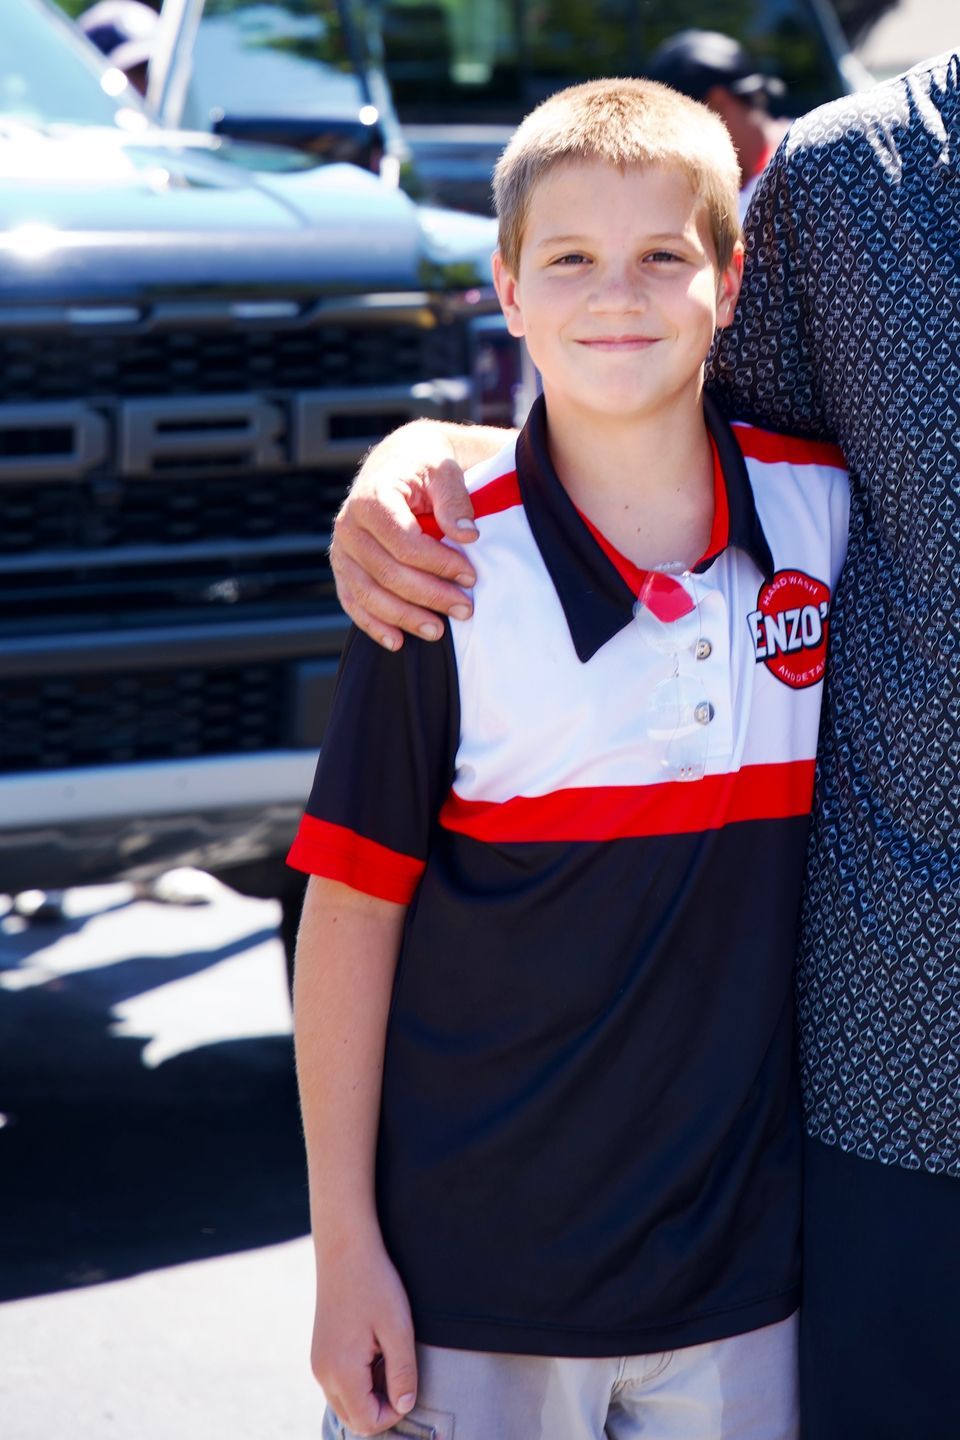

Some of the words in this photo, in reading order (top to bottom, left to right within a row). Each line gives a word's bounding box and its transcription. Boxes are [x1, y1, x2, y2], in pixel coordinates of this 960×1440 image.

[0, 378, 470, 483] ORD
[763, 576, 787, 606] HAND
[788, 575, 818, 596] WASH
[748, 601, 829, 659] ENZO'
